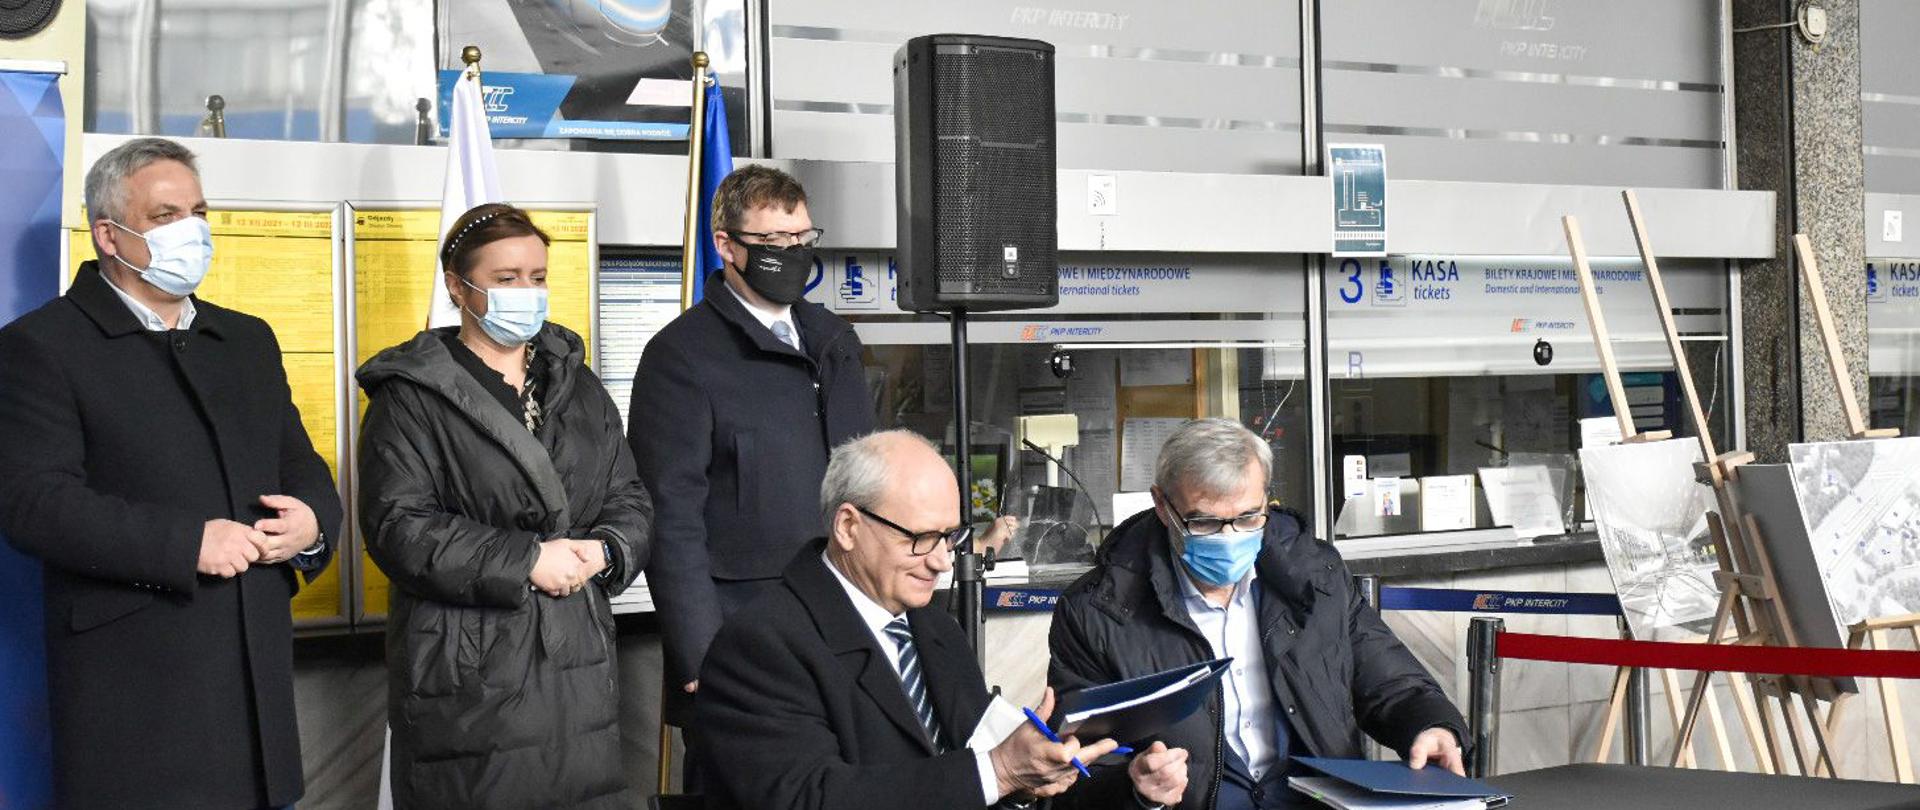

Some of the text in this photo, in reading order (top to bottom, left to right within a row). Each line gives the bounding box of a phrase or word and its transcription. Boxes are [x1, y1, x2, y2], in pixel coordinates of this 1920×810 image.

[1087, 267, 1191, 281] MIĘDZYNARODOWE
[1485, 269, 1513, 280] BILETY
[1515, 269, 1556, 281] KRAJOWE
[1339, 258, 1459, 304] 3 KASA
[1112, 284, 1140, 296] tickets
[1414, 284, 1450, 300] tickets
[1891, 283, 1919, 297] tickets
[1050, 327, 1065, 336] PKP
[1066, 327, 1103, 336] INTERCITY
[1027, 595, 1047, 604] PKP
[1504, 598, 1523, 607] PKP
[1524, 598, 1568, 608] INTERCITY
